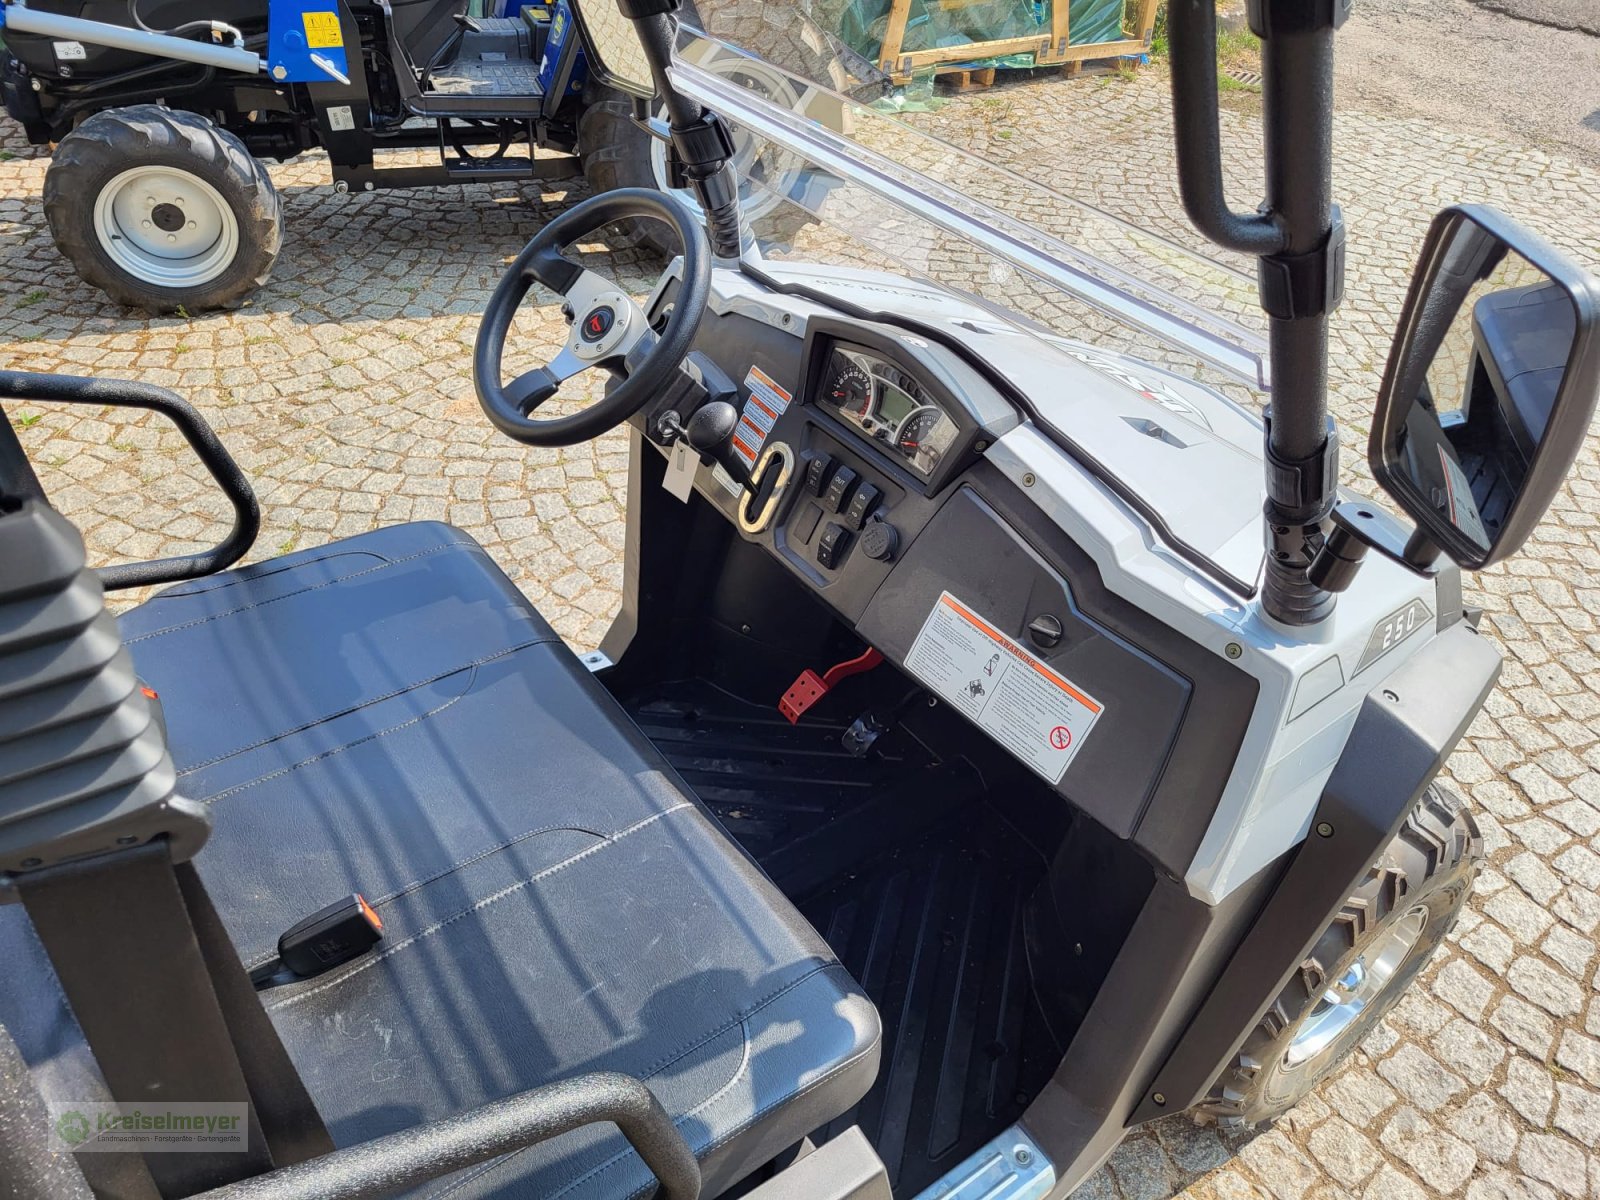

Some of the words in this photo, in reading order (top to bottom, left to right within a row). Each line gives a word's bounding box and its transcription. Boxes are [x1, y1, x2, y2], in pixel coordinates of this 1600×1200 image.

[835, 476, 845, 485] OUT
[1382, 607, 1415, 650] 250
[1002, 640, 1036, 667] WARNING
